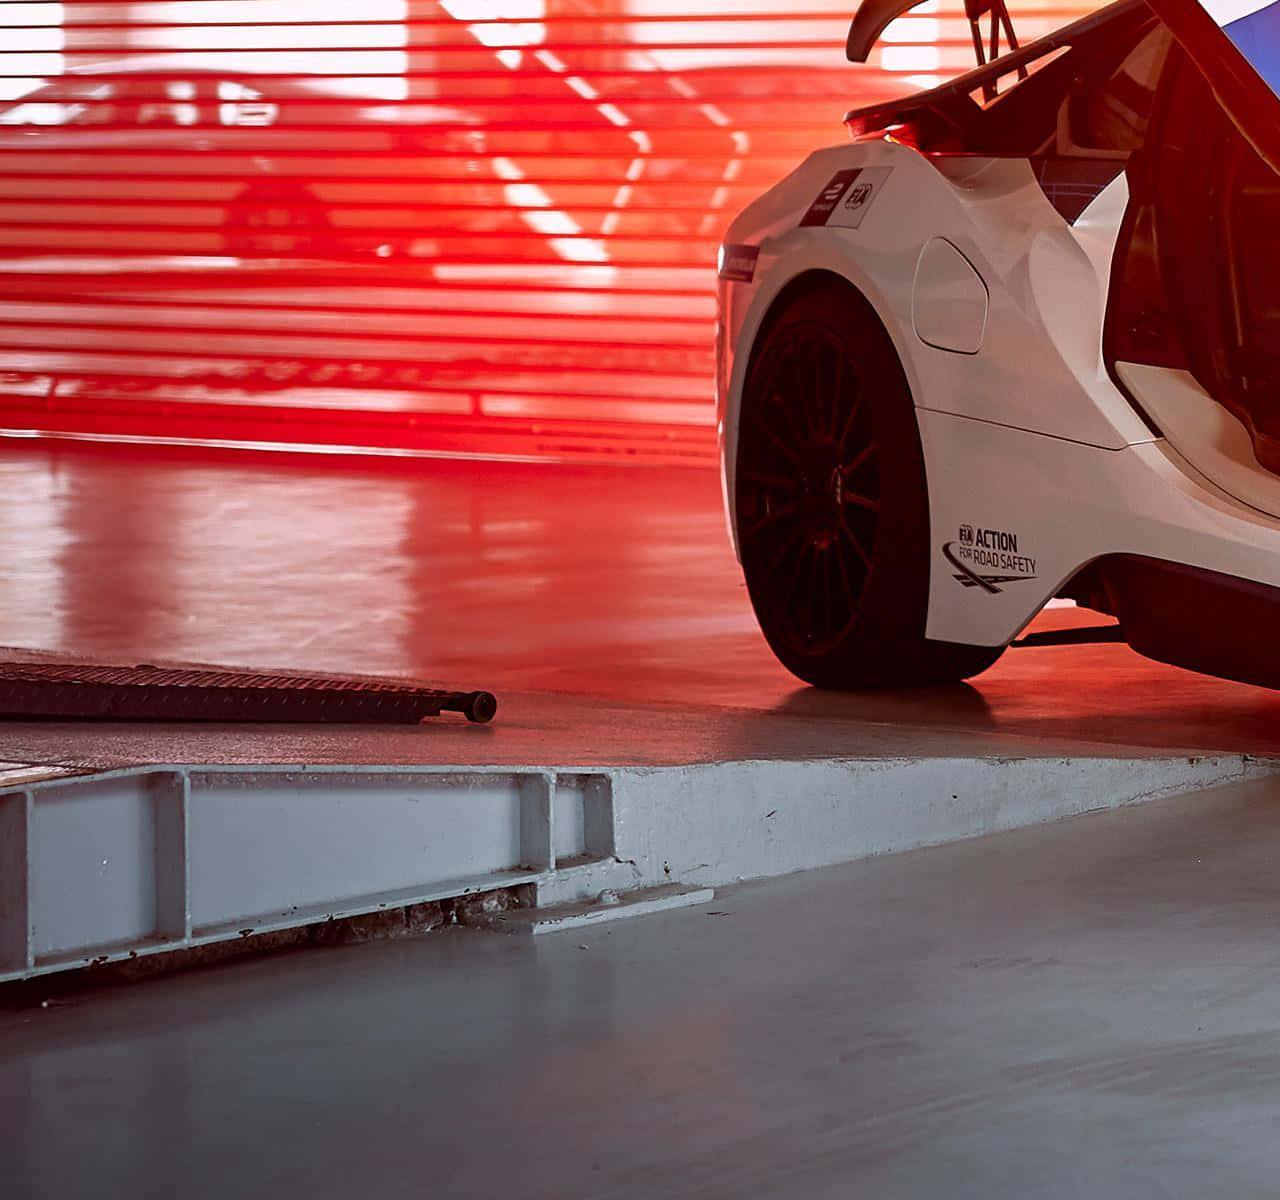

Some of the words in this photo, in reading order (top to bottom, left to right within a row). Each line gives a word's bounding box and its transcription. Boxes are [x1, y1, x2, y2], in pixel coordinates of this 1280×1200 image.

[976, 528, 1018, 553] ACTION
[960, 546, 972, 560] FOR
[973, 549, 999, 568] ROAD
[1000, 554, 1037, 574] SAFETY
